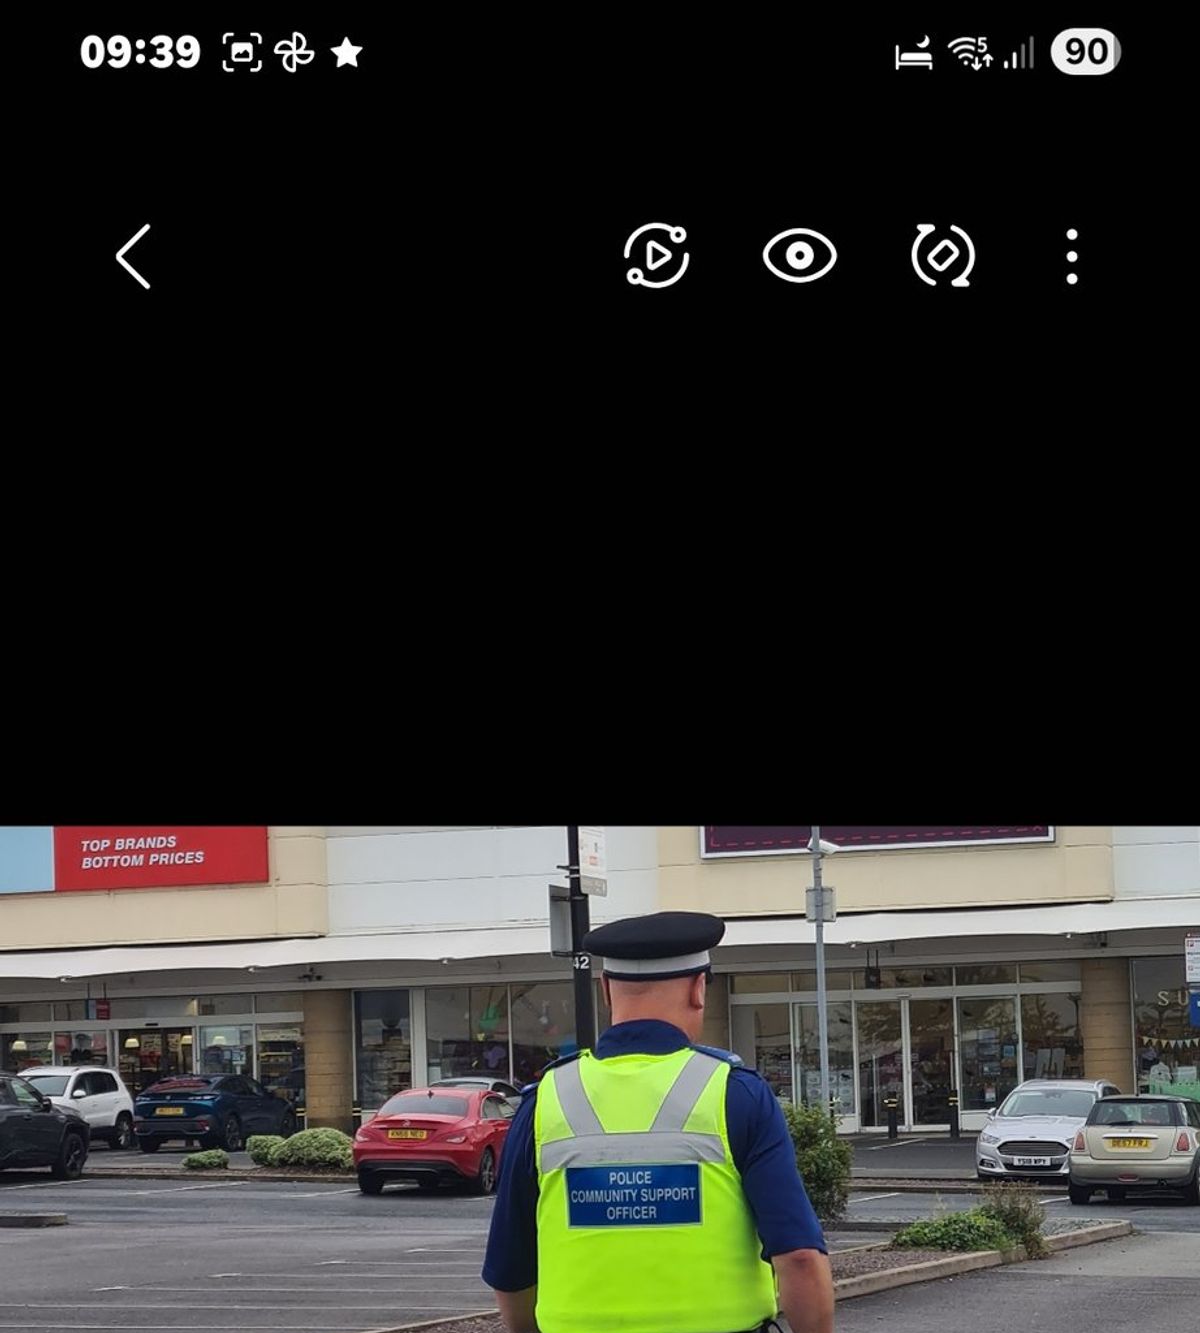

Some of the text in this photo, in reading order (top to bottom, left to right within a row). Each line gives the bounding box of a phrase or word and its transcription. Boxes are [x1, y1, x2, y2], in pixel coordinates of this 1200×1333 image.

[80, 34, 201, 68] 09:39
[1066, 37, 1109, 65] 90
[80, 836, 177, 852] TOP BRANDS
[81, 851, 205, 869] BOTTOM PRICES
[609, 1171, 652, 1185] POLICE
[571, 1187, 697, 1203] COMMUNITY SUPPORT
[607, 1206, 657, 1220] OFFICER
